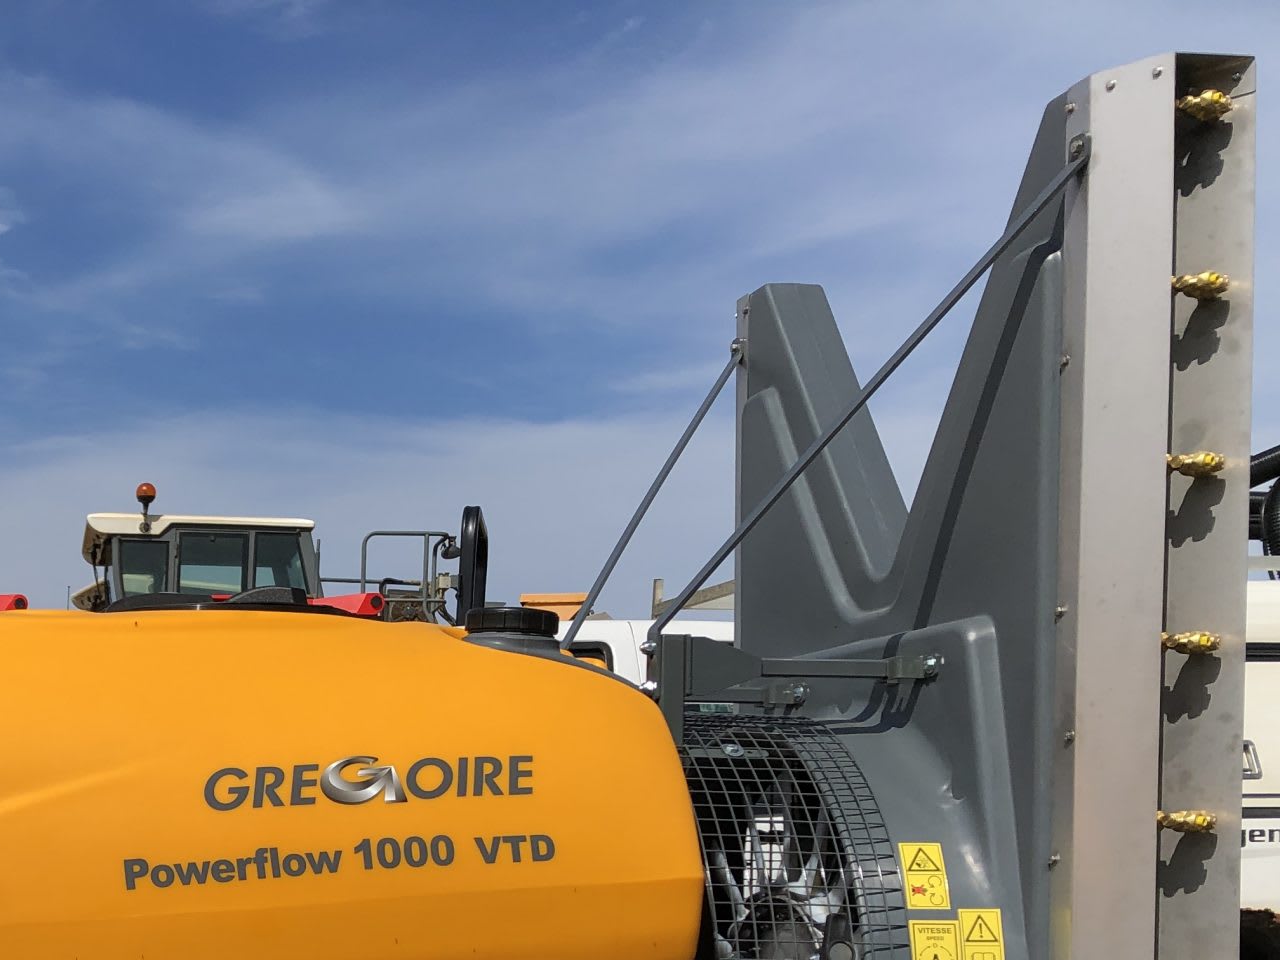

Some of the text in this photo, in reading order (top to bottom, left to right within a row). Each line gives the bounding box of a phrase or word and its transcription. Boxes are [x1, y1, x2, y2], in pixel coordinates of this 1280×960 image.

[204, 755, 533, 811] GREGOIRE
[123, 834, 556, 891] Powerflow 1000 VTD
[1241, 829, 1280, 848] en
